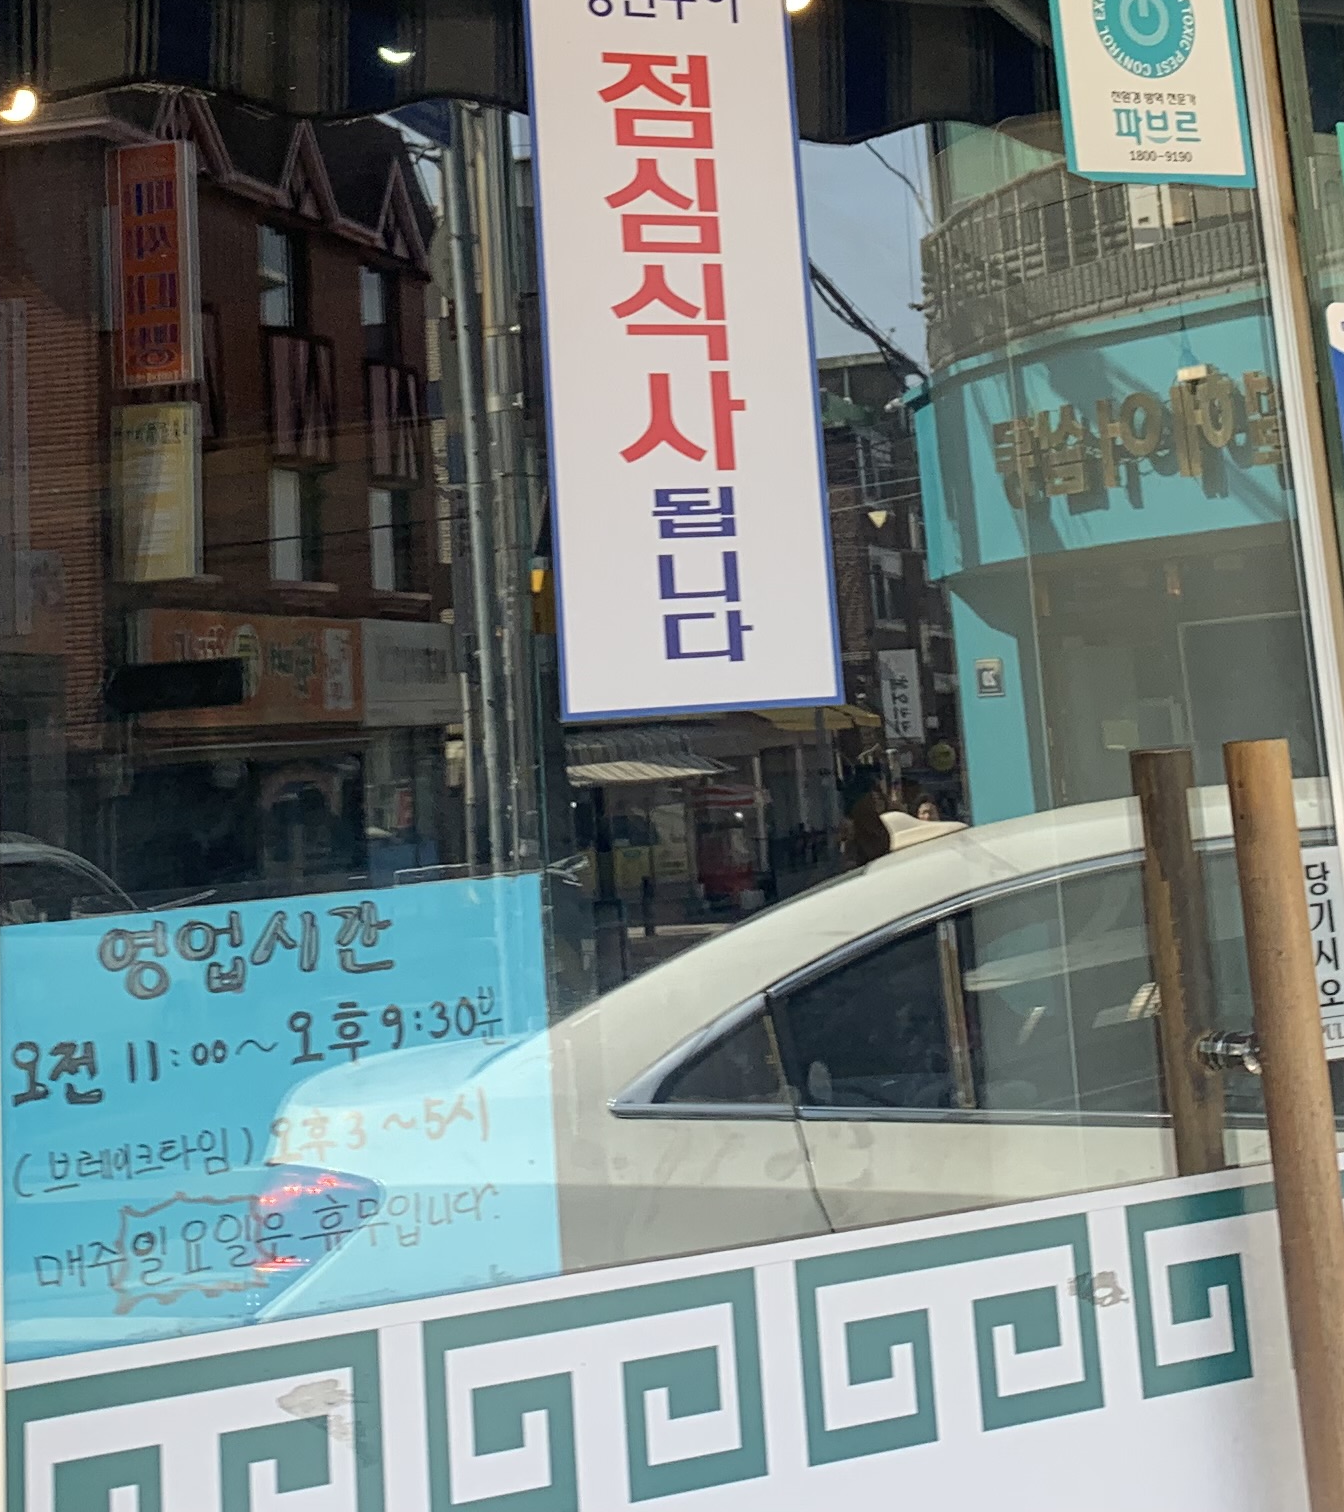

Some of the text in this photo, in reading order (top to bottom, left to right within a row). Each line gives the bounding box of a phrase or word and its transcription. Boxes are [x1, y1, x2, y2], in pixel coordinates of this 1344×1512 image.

[1099, 24, 1153, 77] CONTROL
[1180, 7, 1195, 52] TOXIC
[1154, 50, 1186, 77] PEST
[1112, 107, 1202, 146] 파브르
[1129, 149, 1194, 163] 1800-9190
[97, 899, 397, 1001] 영업시간
[10, 1039, 106, 1108] 오전
